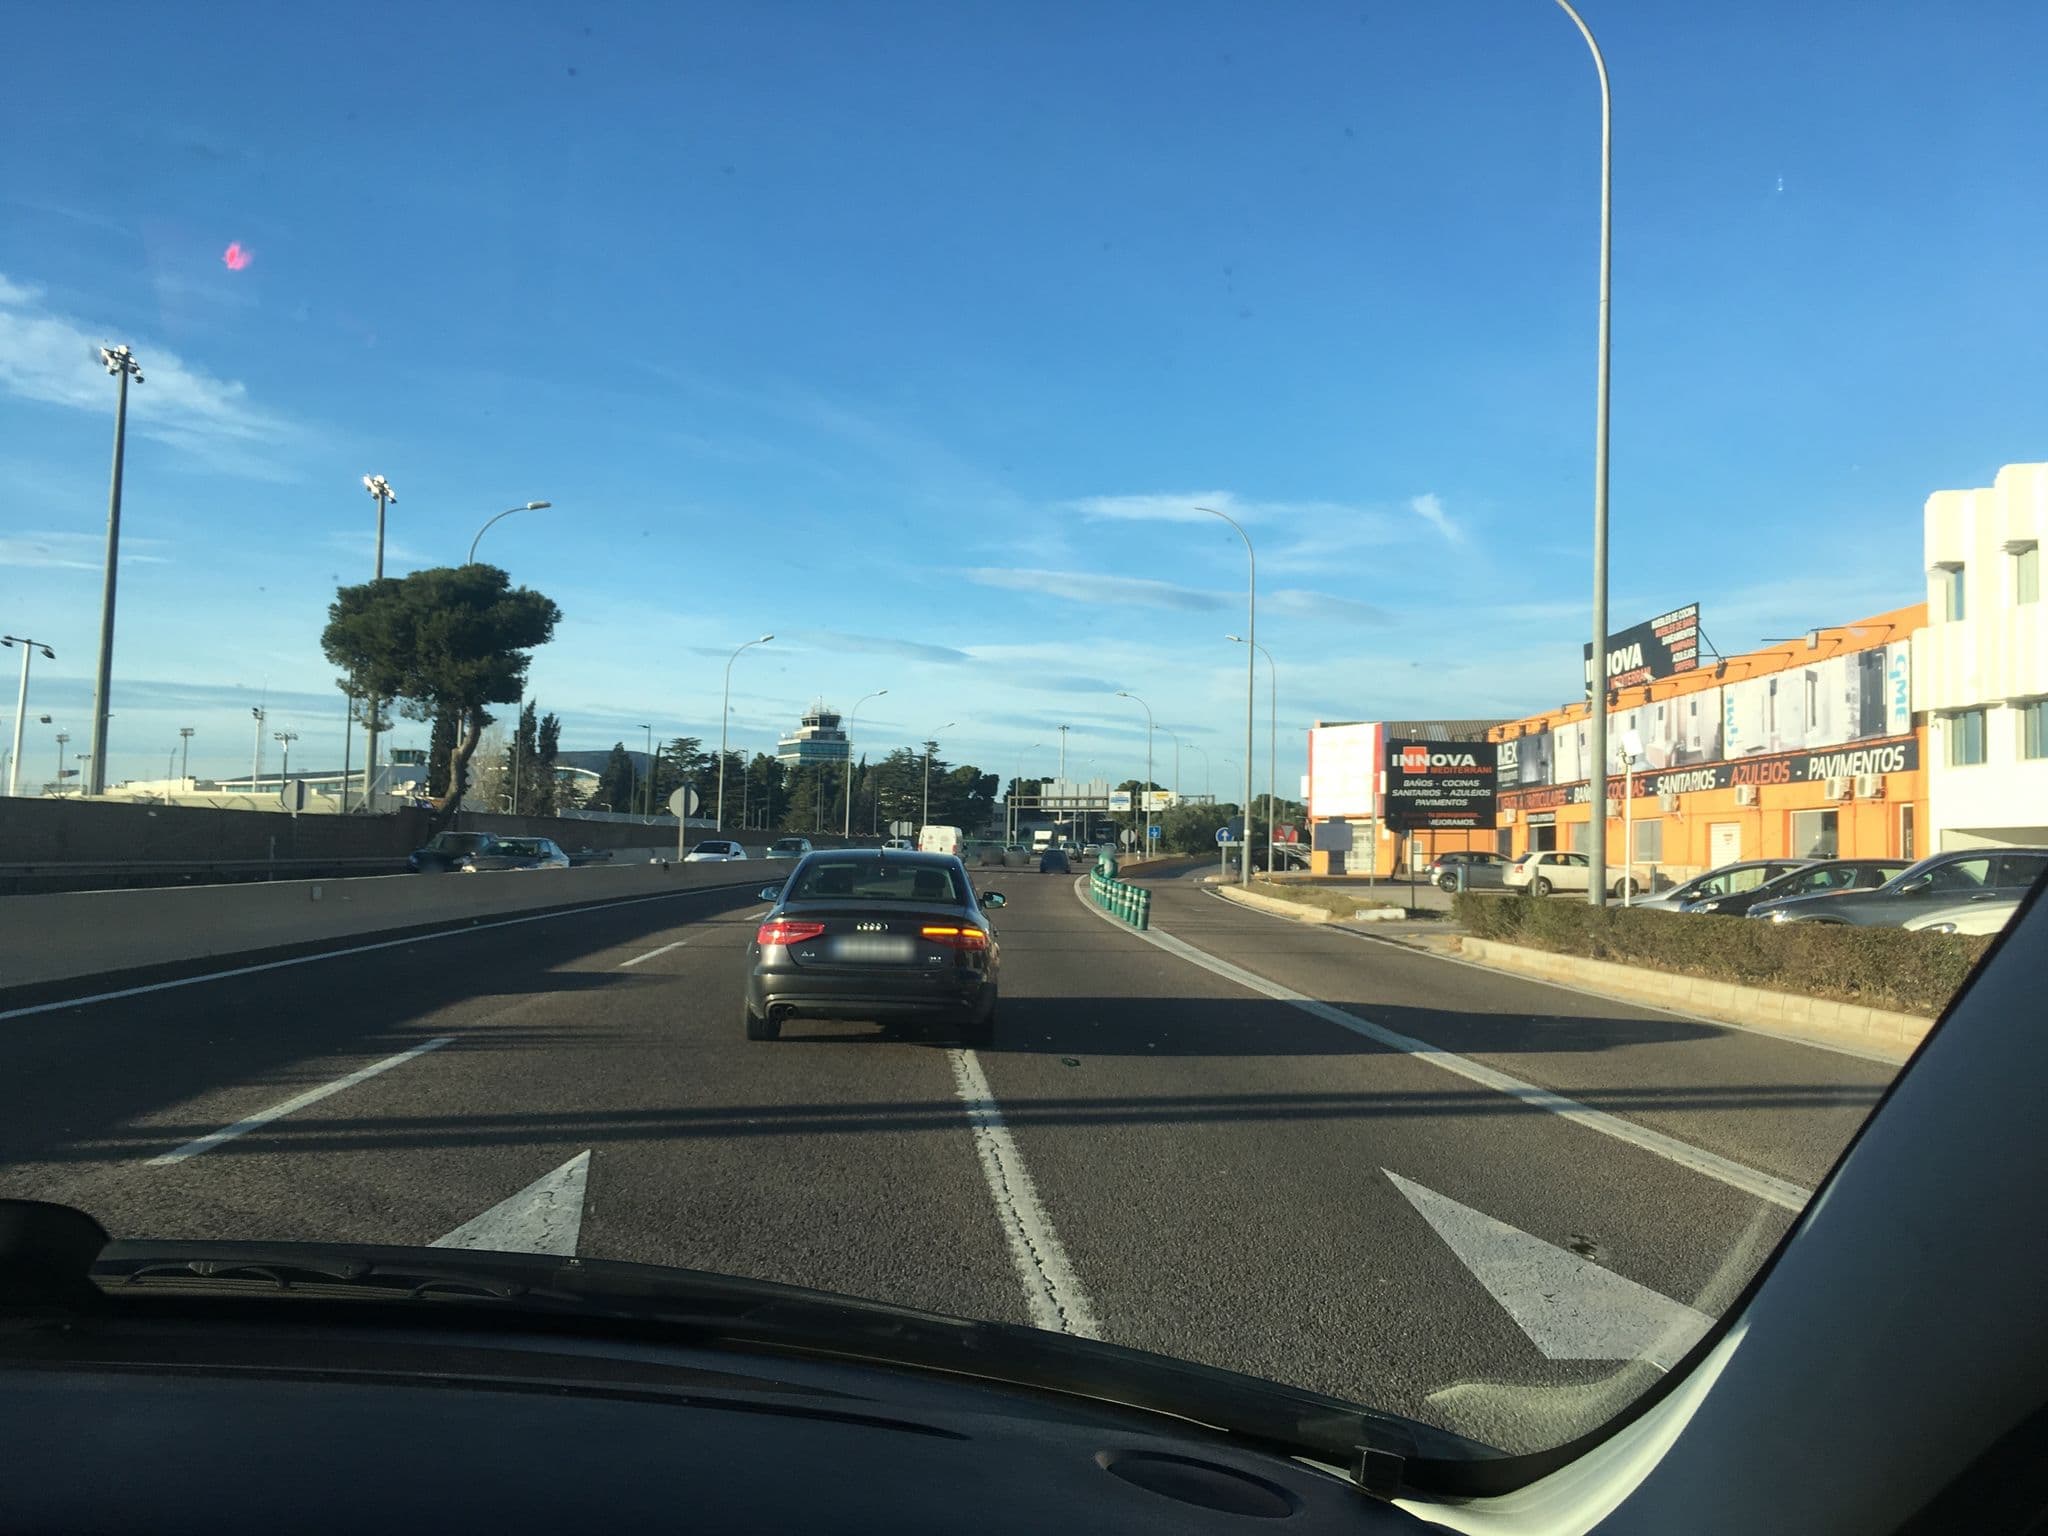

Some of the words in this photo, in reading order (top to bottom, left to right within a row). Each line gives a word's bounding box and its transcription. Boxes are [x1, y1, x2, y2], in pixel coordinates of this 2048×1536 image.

[1585, 642, 1643, 683] IOVA
[1391, 753, 1477, 767] INNOVA
[1573, 783, 1591, 804] BAÑ
[1607, 779, 1646, 800] COCAS
[1656, 769, 1716, 796] SANITARIOS
[1730, 761, 1791, 787] AZULEJOS
[1808, 745, 1906, 780] PAVIMENTOS
[1403, 778, 1433, 787] BAÑOS
[1441, 779, 1480, 787] COCINAS
[1391, 789, 1441, 797] SANITARIOS
[1449, 789, 1492, 797] AZULEJOS
[1415, 798, 1469, 806] PAVIMENTOS
